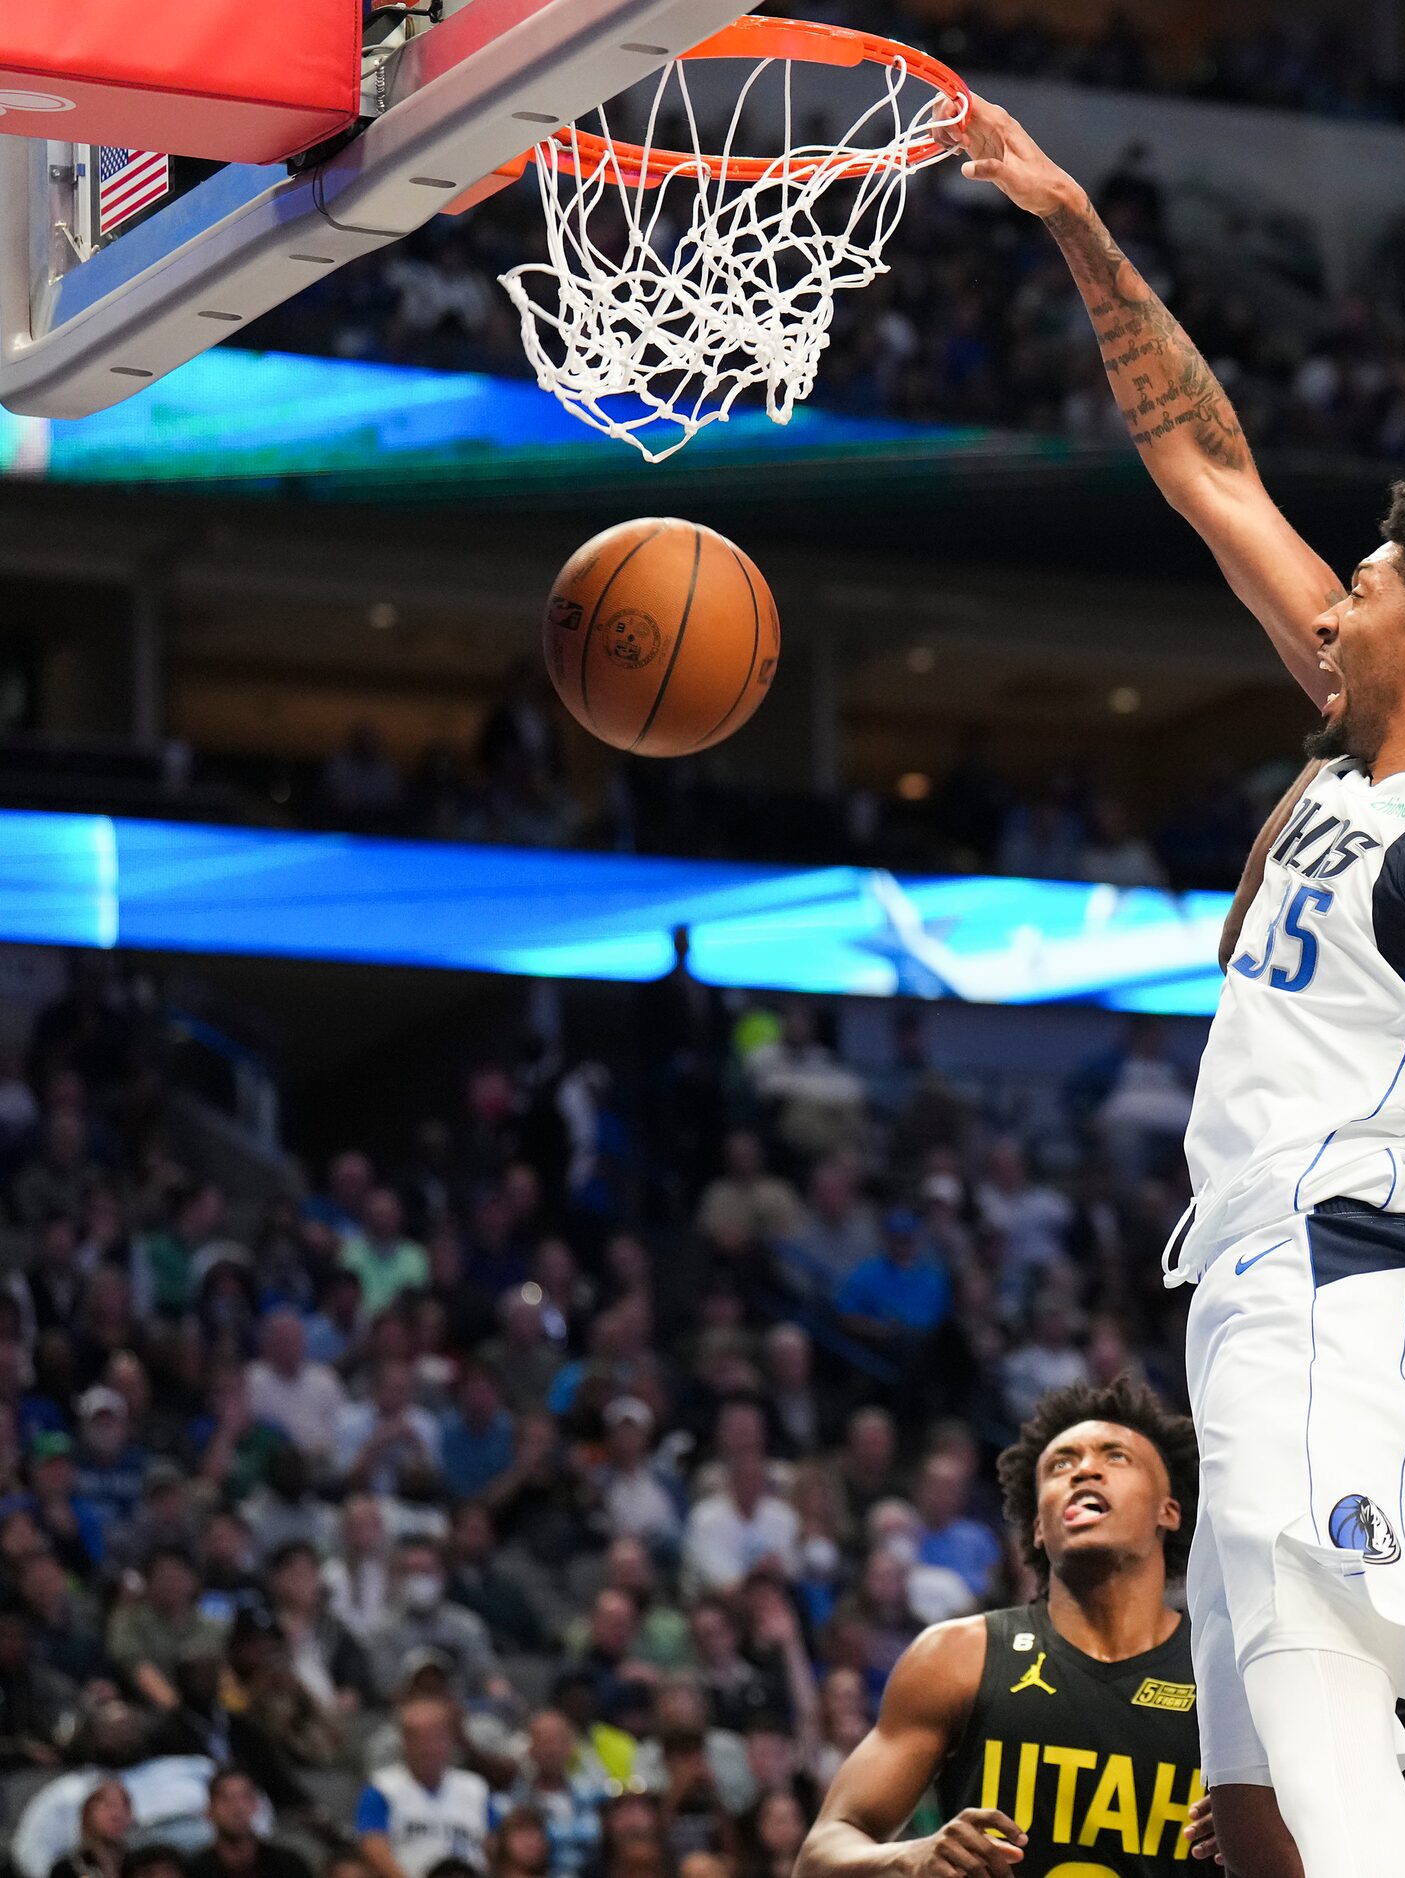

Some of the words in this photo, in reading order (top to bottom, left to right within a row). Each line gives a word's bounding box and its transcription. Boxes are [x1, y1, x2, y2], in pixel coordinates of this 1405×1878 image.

[1012, 1632, 1035, 1651] 6
[1138, 1682, 1159, 1703] 5
[980, 1739, 1207, 1861] UTAH
